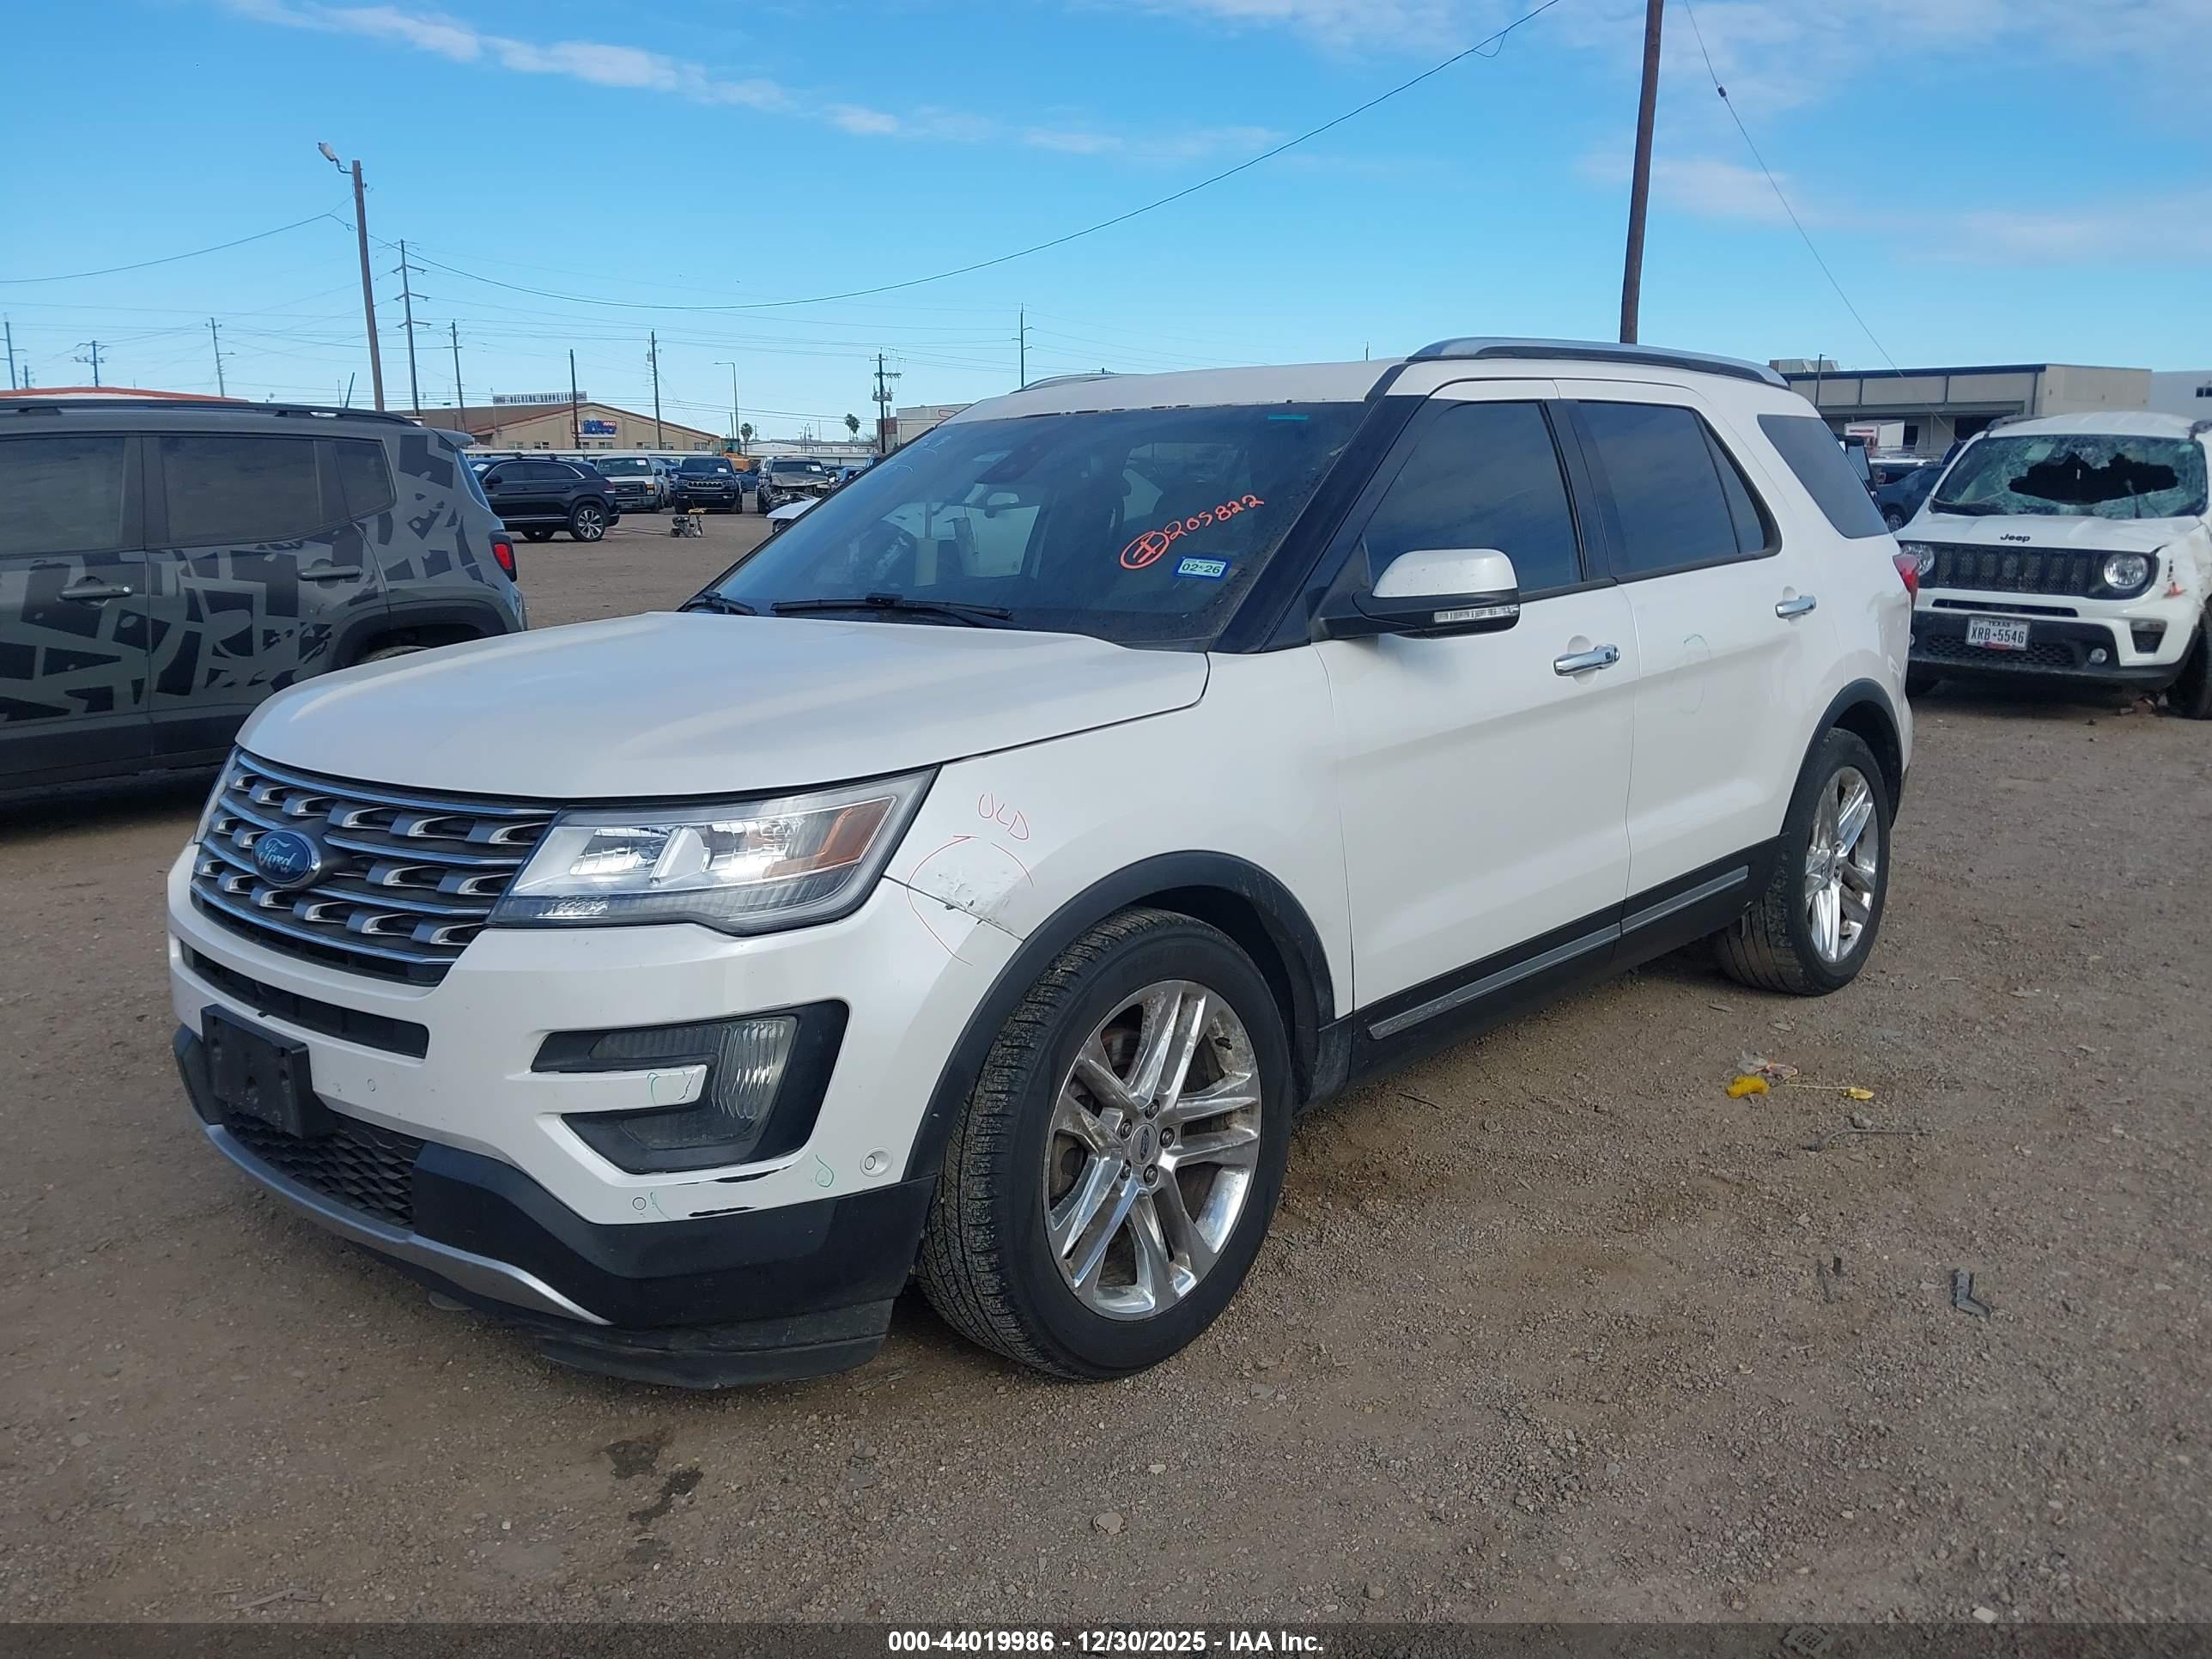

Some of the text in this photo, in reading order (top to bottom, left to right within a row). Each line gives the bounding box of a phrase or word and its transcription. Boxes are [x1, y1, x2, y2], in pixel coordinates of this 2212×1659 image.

[1164, 494, 1265, 540] 205822
[2000, 533, 2031, 543] Jeep
[258, 838, 297, 872] Ford
